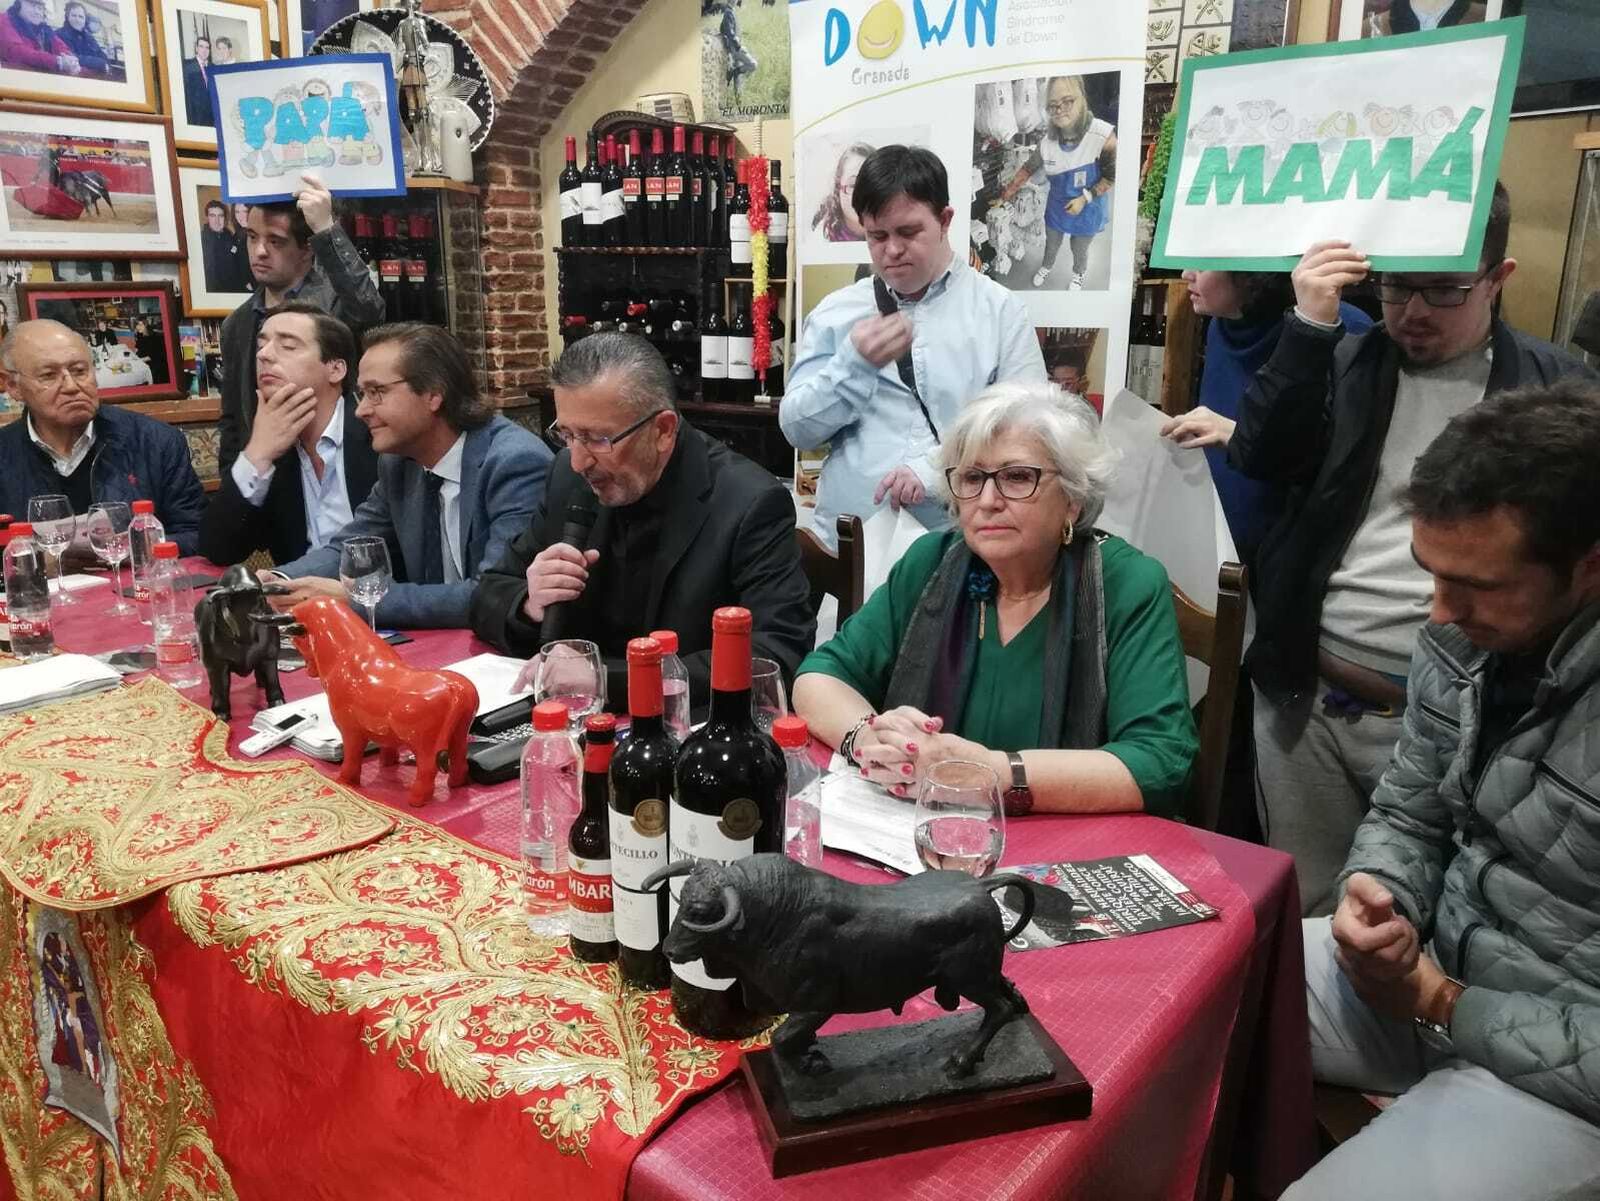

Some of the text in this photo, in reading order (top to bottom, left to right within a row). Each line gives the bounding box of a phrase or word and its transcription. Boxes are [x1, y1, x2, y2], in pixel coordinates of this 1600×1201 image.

[824, 0, 998, 67] DOWN
[1023, 31, 1057, 43] Down
[851, 63, 911, 86] Granada
[1185, 106, 1485, 206] MAMÁ
[611, 843, 658, 859] TECILLO
[526, 876, 555, 889] arón
[568, 875, 612, 899] MBAR
[1123, 862, 1160, 891] BLANCO
[1156, 889, 1192, 916] JAVIER
